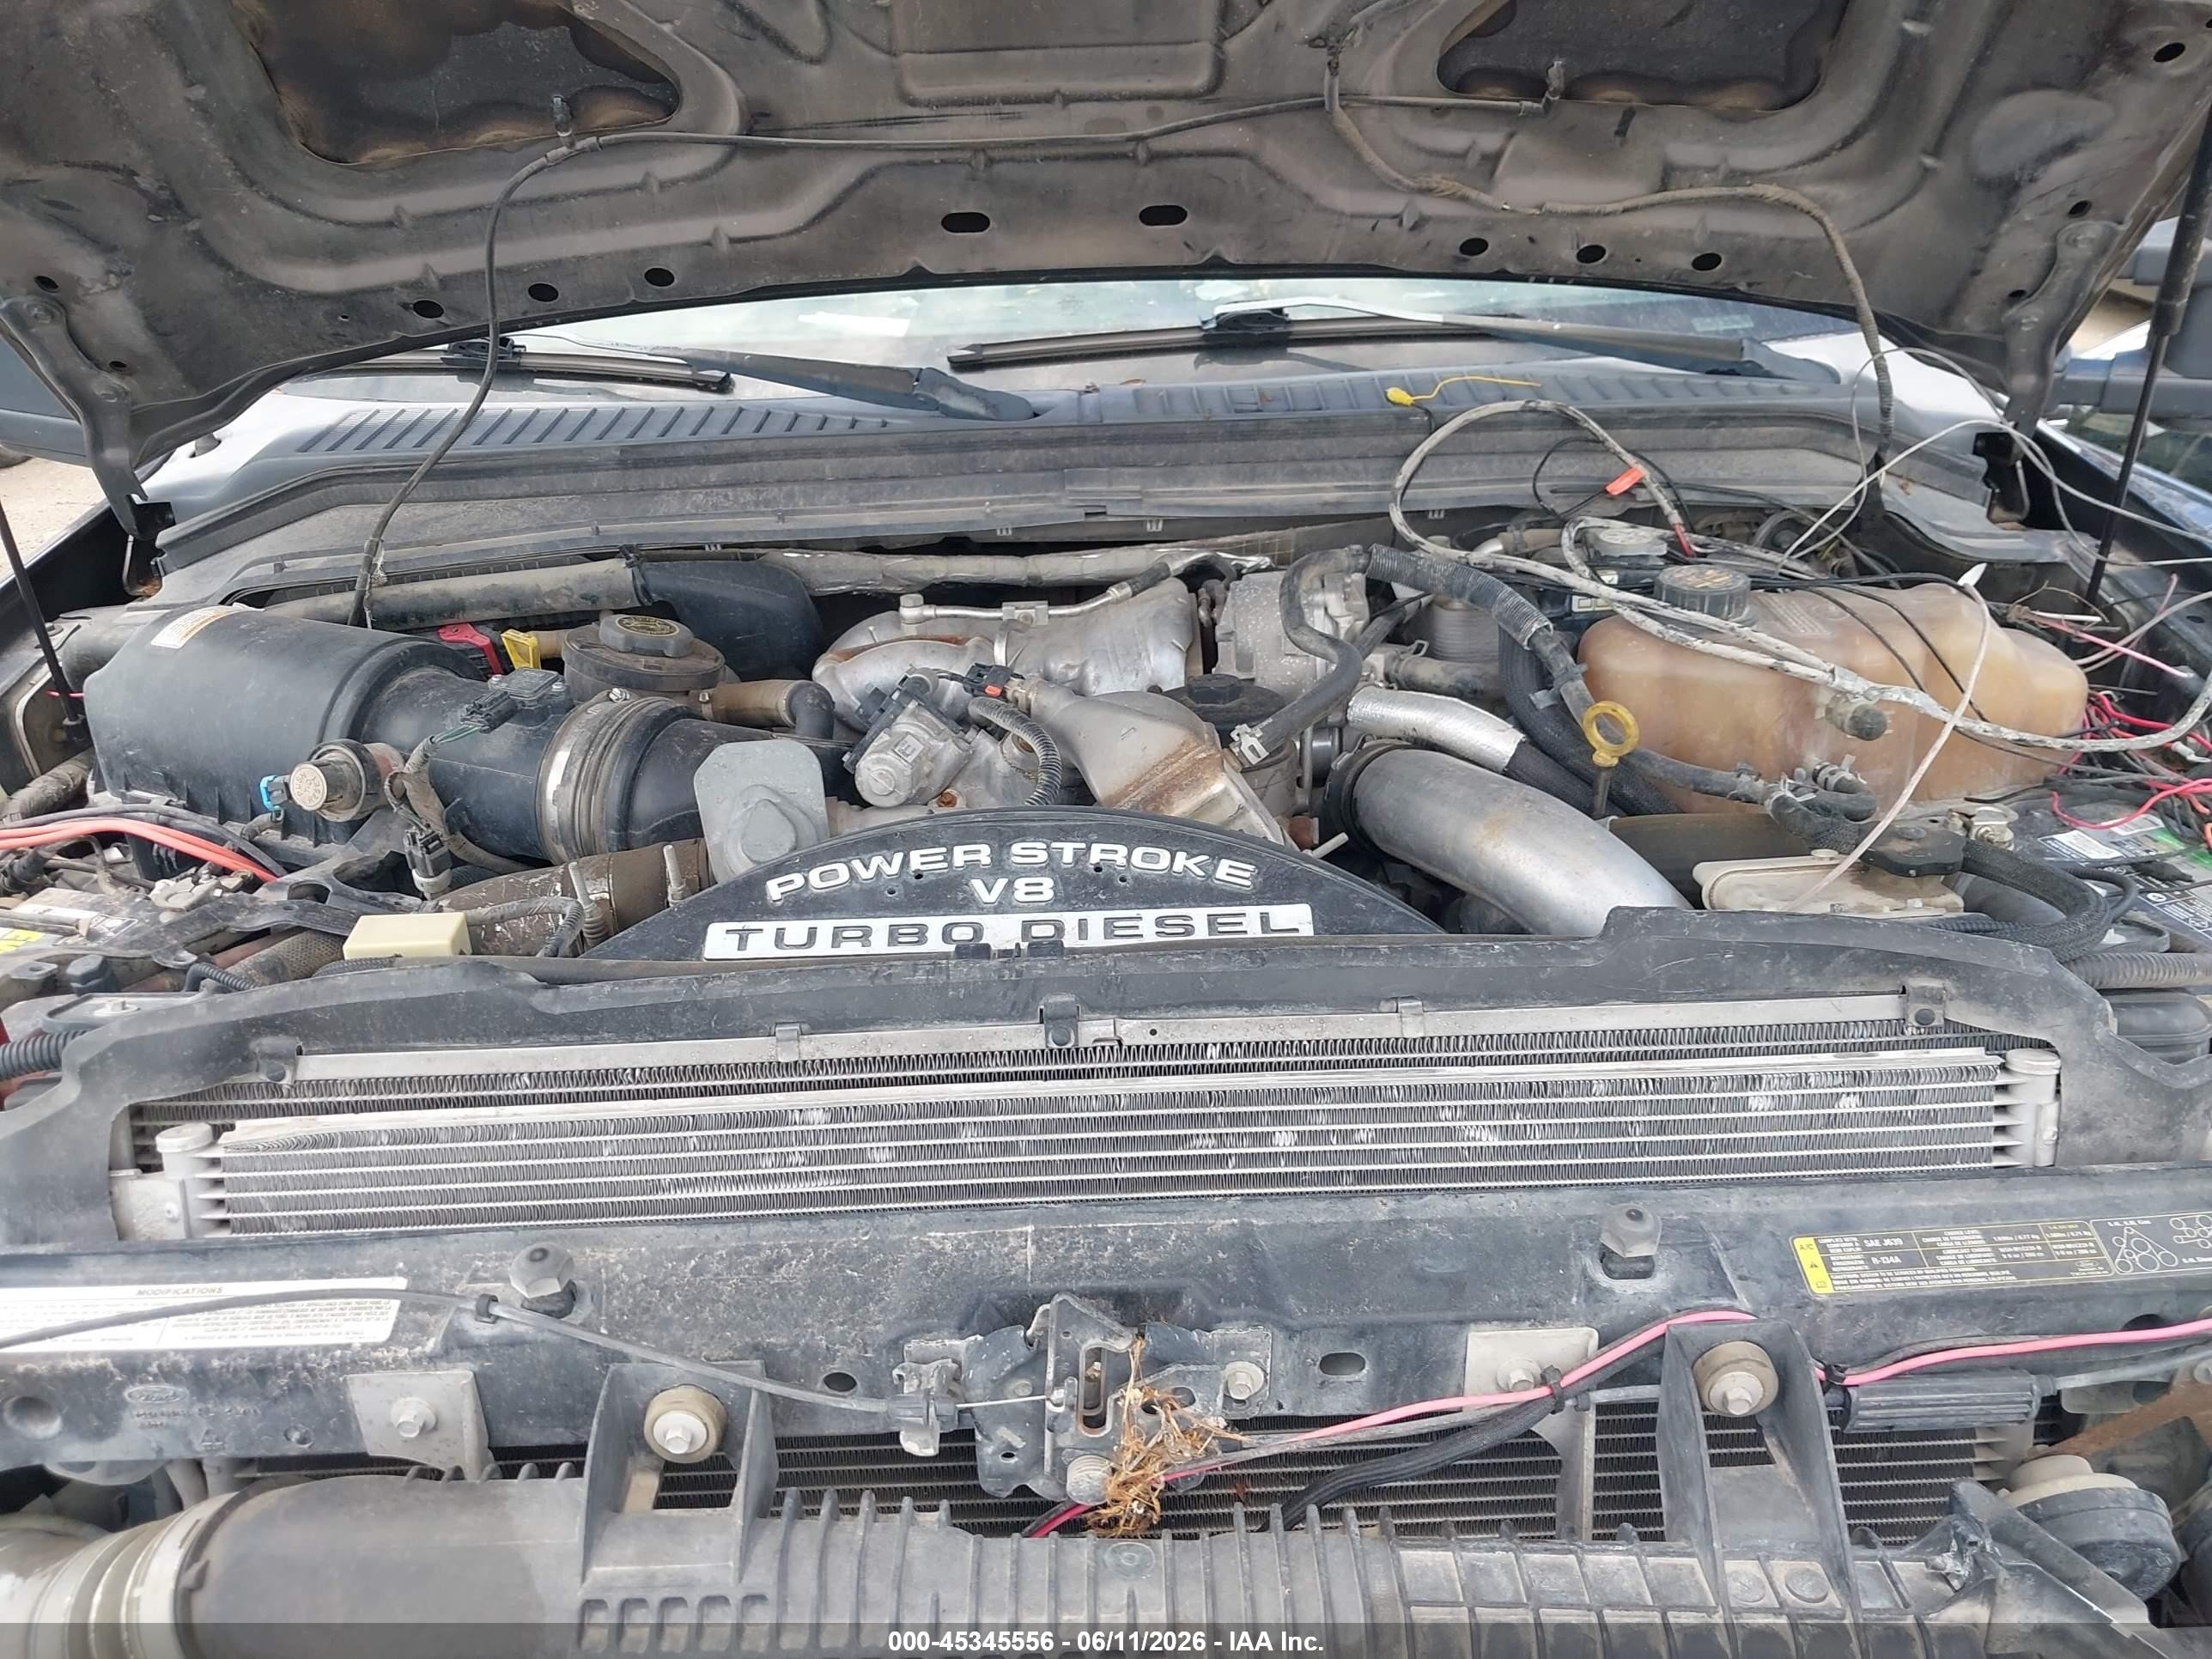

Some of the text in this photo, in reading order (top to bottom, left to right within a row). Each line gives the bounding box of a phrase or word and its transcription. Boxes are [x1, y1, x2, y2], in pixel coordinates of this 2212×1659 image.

[765, 842, 1257, 902] POWER STROKE
[969, 877, 1055, 904] V8
[725, 912, 1300, 951] TURBO DIESEL
[1870, 1255, 1902, 1265] R-134A
[136, 1286, 223, 1296] MODIFICATIONS
